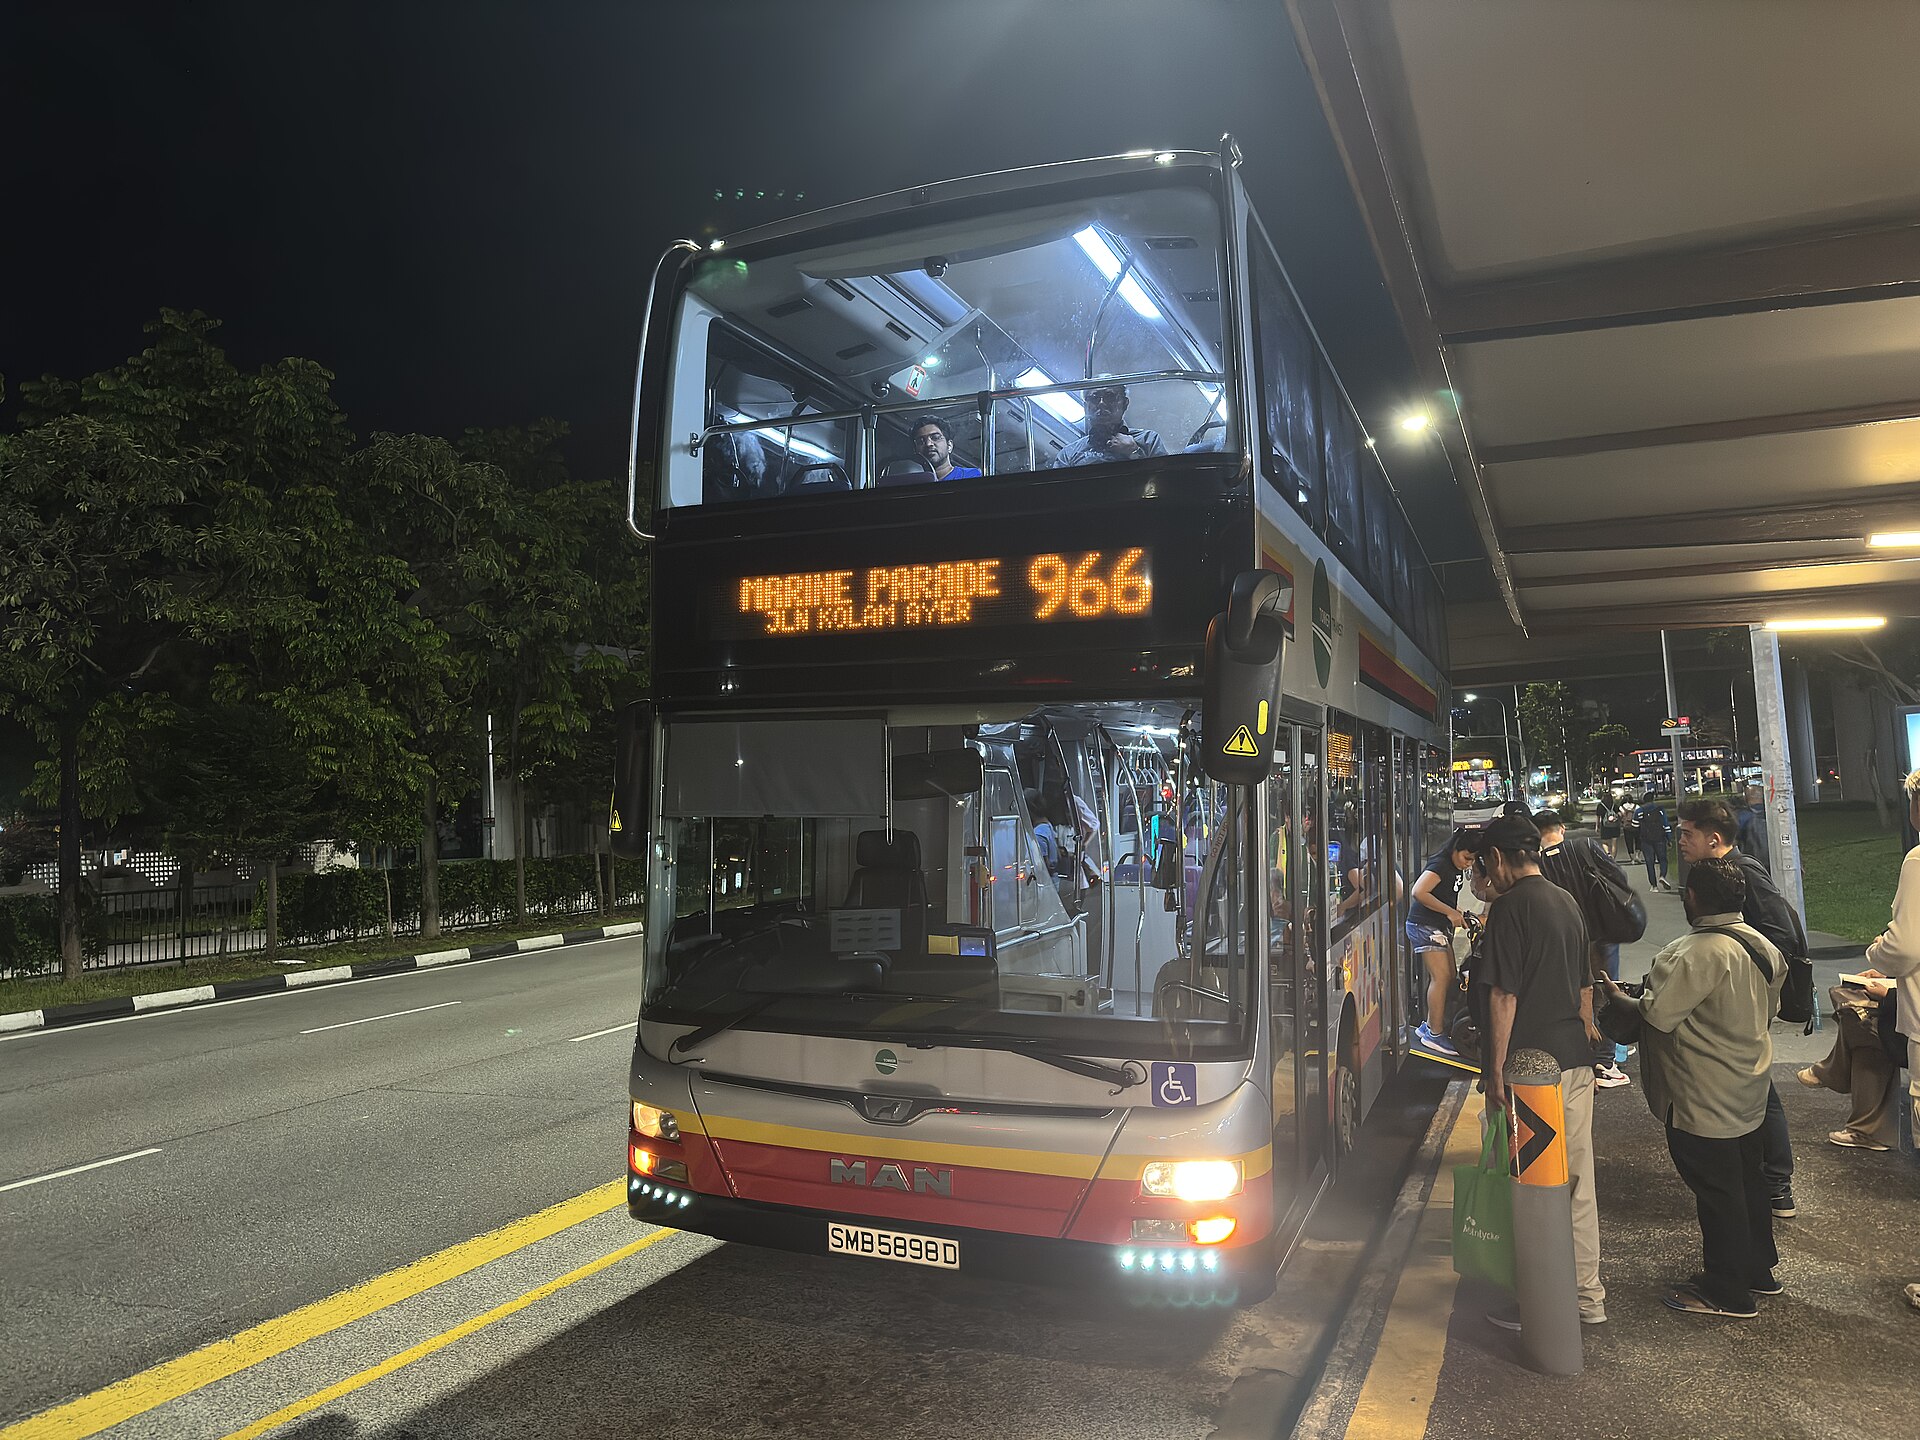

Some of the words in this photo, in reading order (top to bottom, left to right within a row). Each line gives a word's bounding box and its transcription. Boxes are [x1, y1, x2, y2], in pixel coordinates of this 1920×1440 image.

[738, 571, 853, 613] MARINE
[868, 560, 1000, 602] PARADE
[1028, 547, 1152, 619] 966
[764, 608, 809, 634] JLN
[817, 603, 895, 631] KOLAM
[904, 599, 971, 626] AYER
[829, 1158, 954, 1198] MAN
[831, 1227, 957, 1264] SMB5898D
